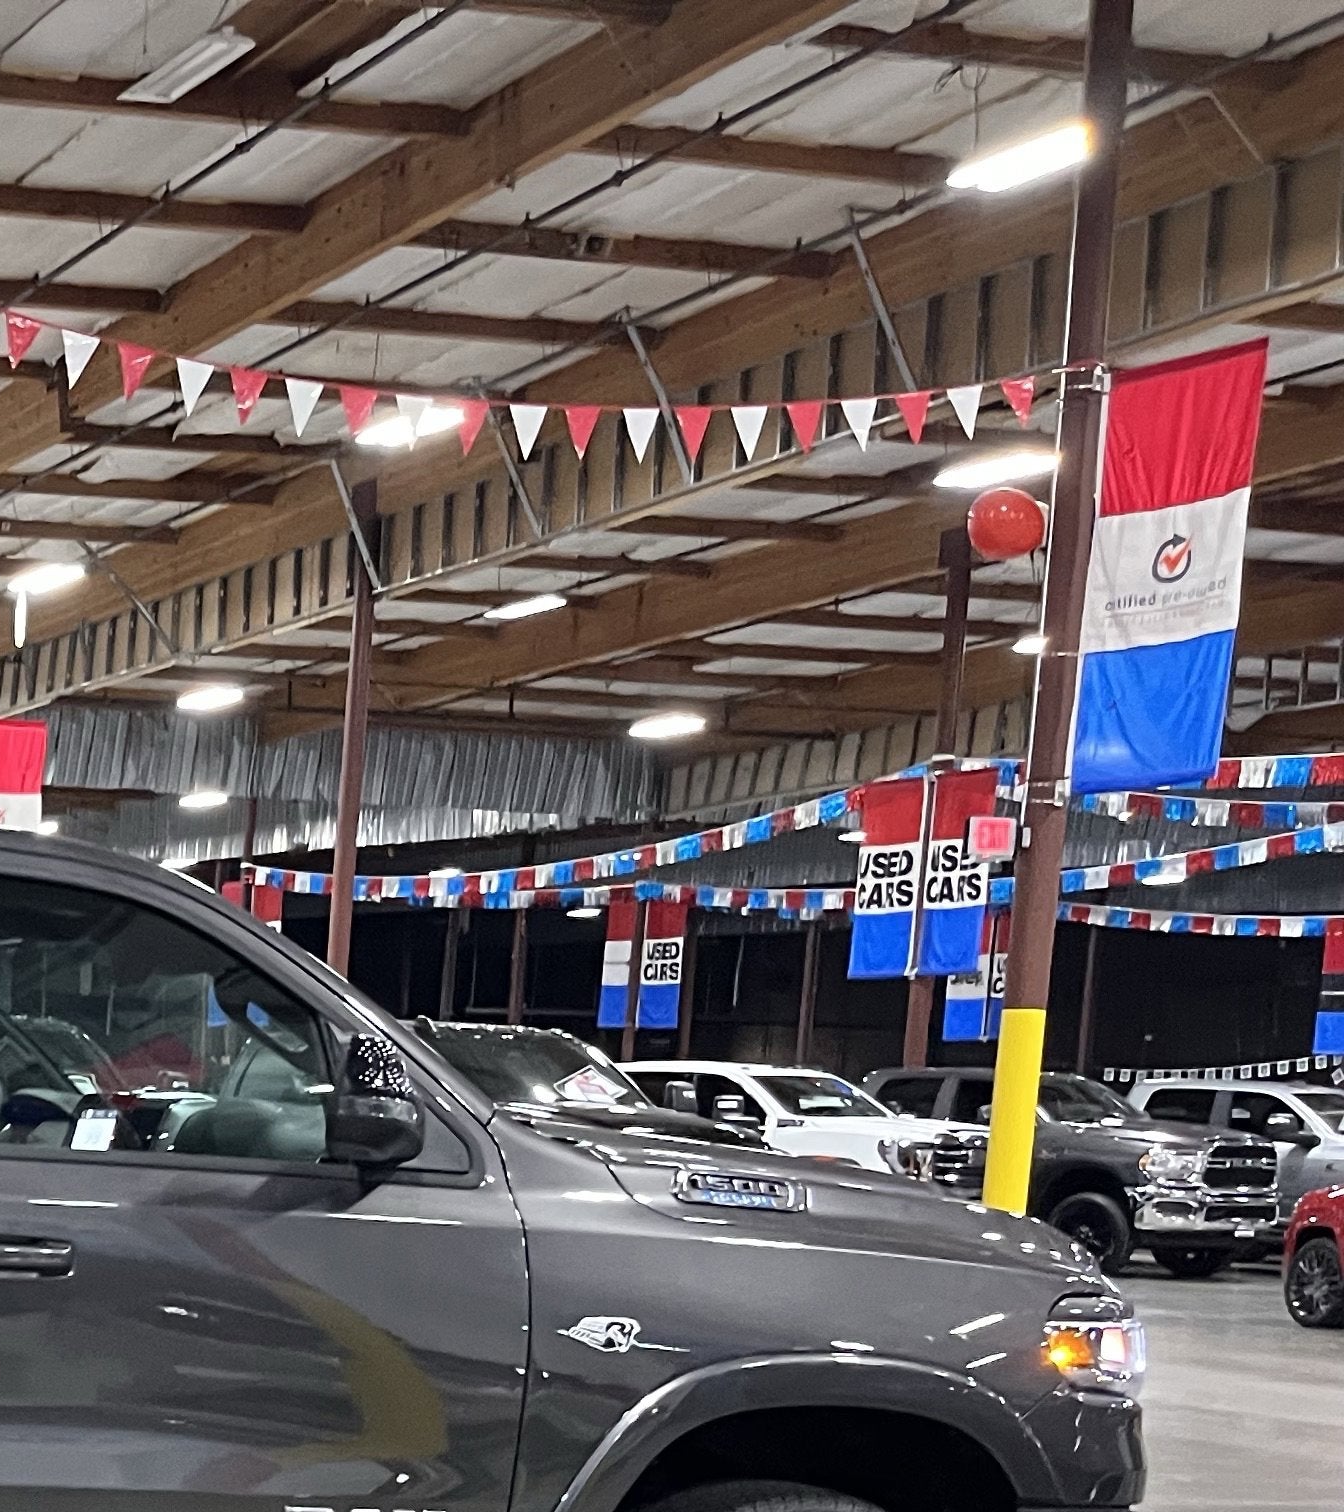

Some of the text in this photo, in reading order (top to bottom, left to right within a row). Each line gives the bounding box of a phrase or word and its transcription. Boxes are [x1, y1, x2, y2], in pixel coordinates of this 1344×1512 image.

[1104, 593, 1156, 611] ctified
[859, 850, 914, 879] USED
[930, 845, 980, 872] USE
[858, 880, 914, 909] CARS
[925, 873, 982, 903] CARS
[646, 942, 680, 960] USED
